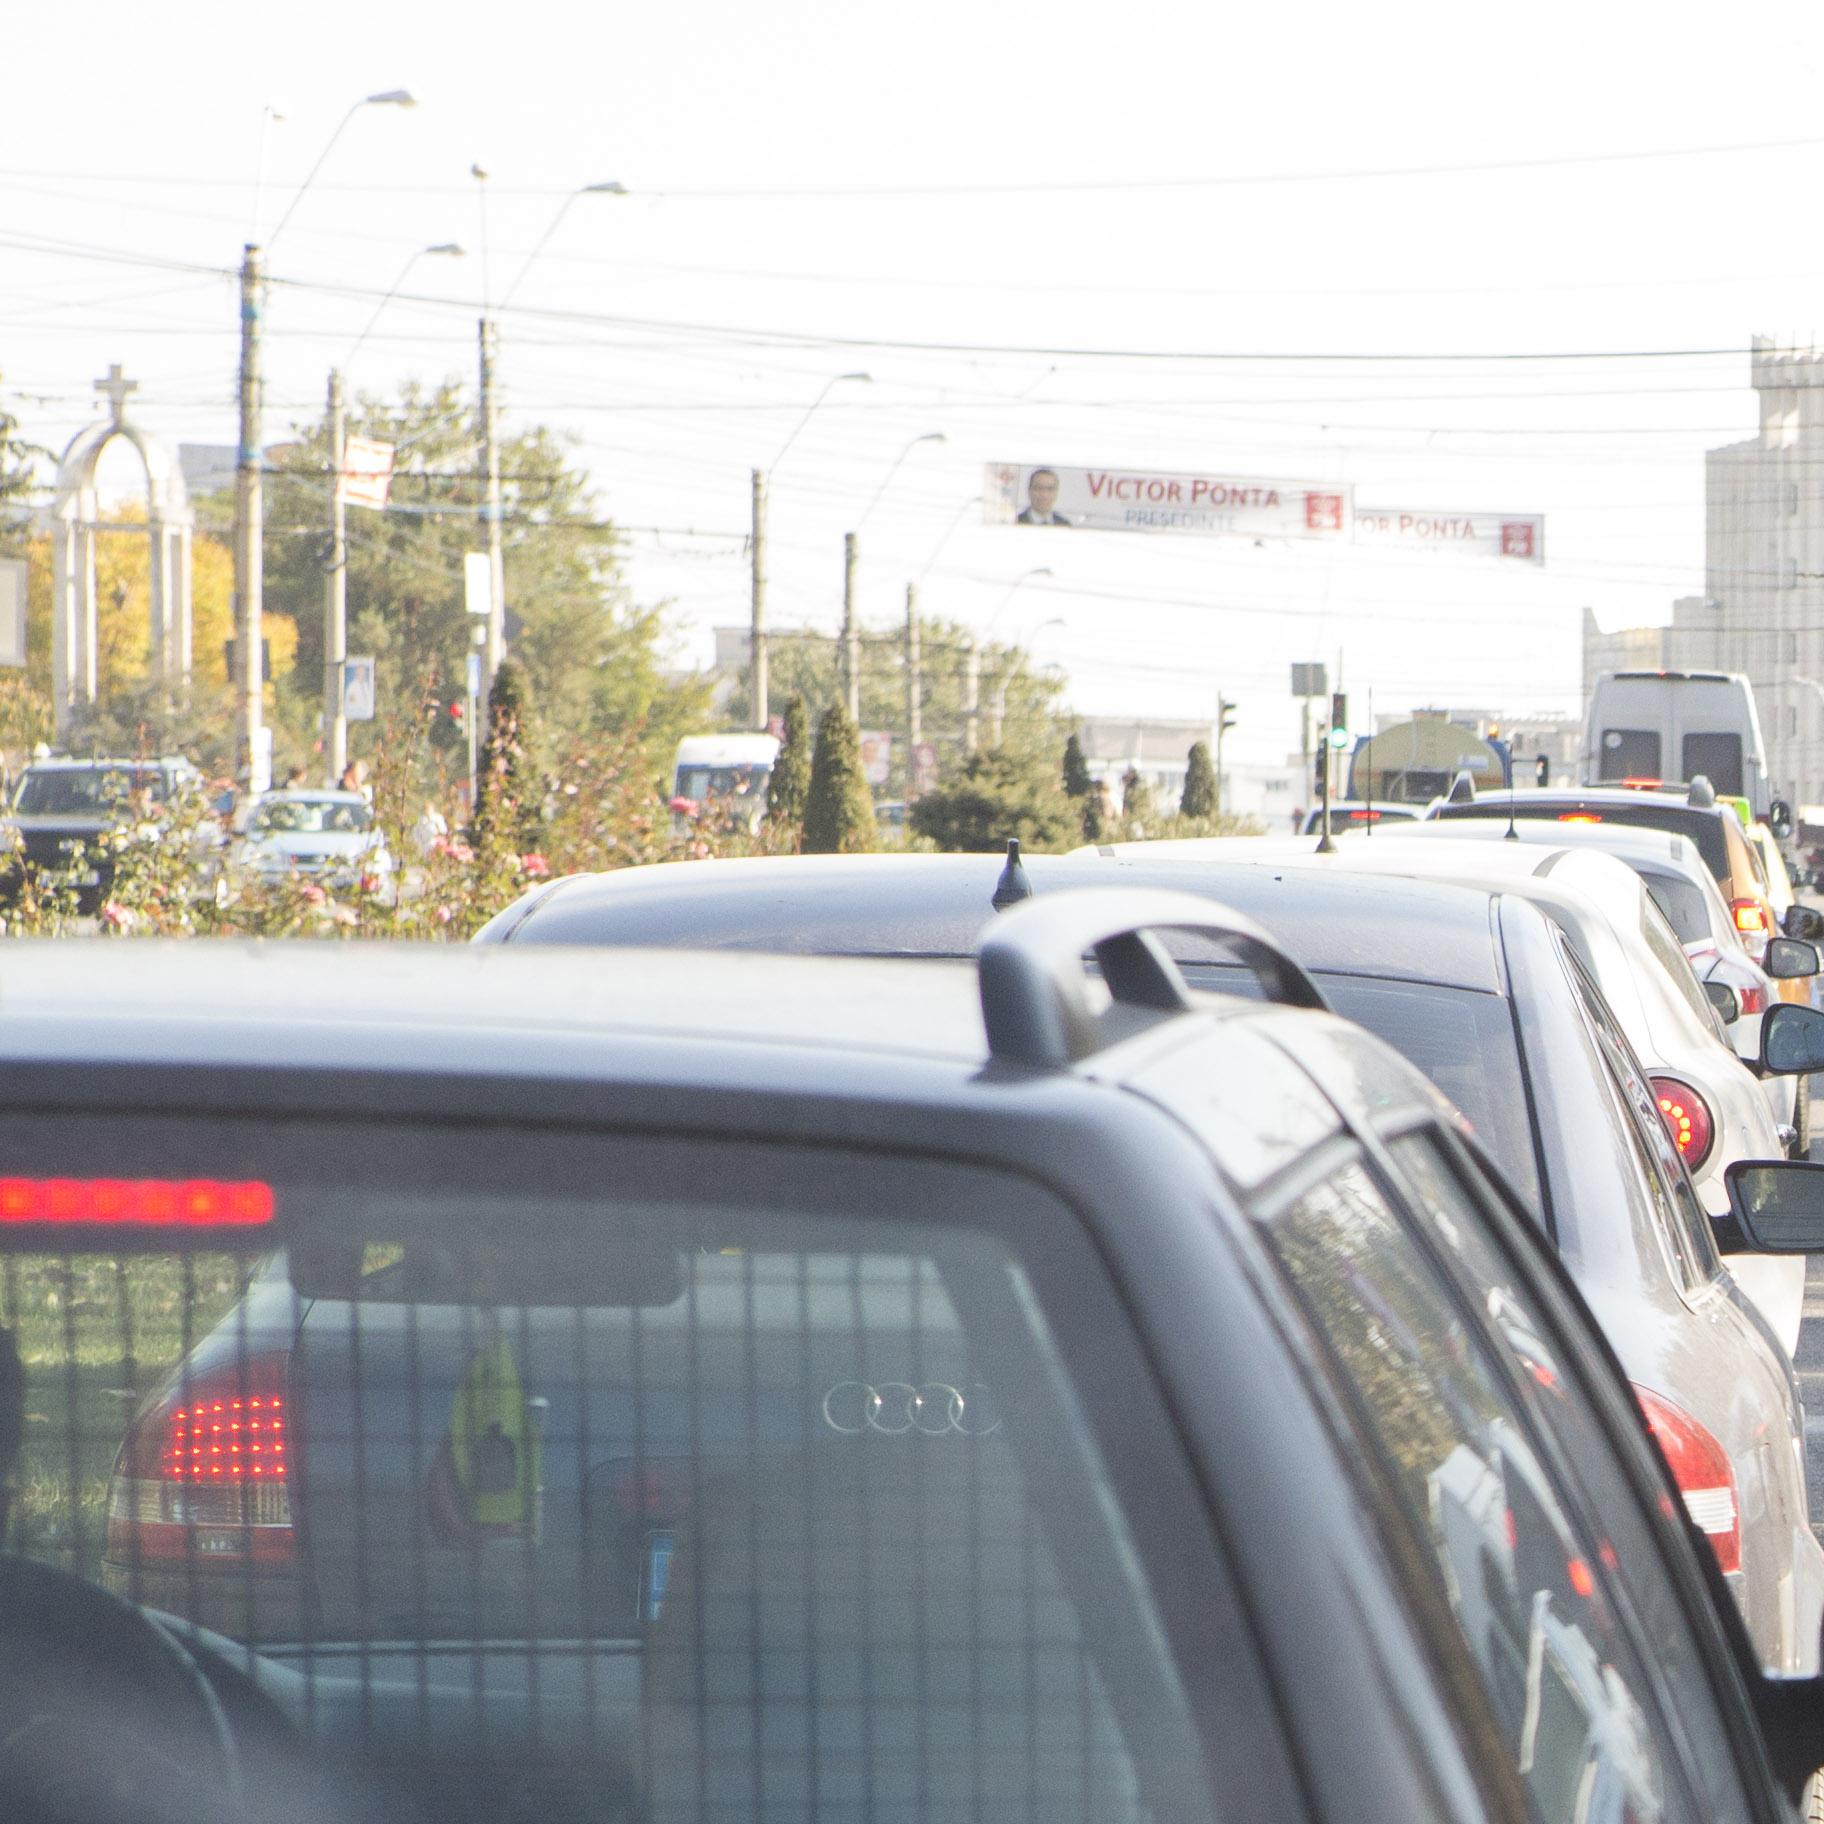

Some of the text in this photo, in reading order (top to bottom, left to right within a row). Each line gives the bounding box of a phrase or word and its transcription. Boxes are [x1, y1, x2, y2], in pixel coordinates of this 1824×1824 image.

[1087, 472, 1281, 508] VICTOR PONTA
[1400, 515, 1476, 539] PONTA
